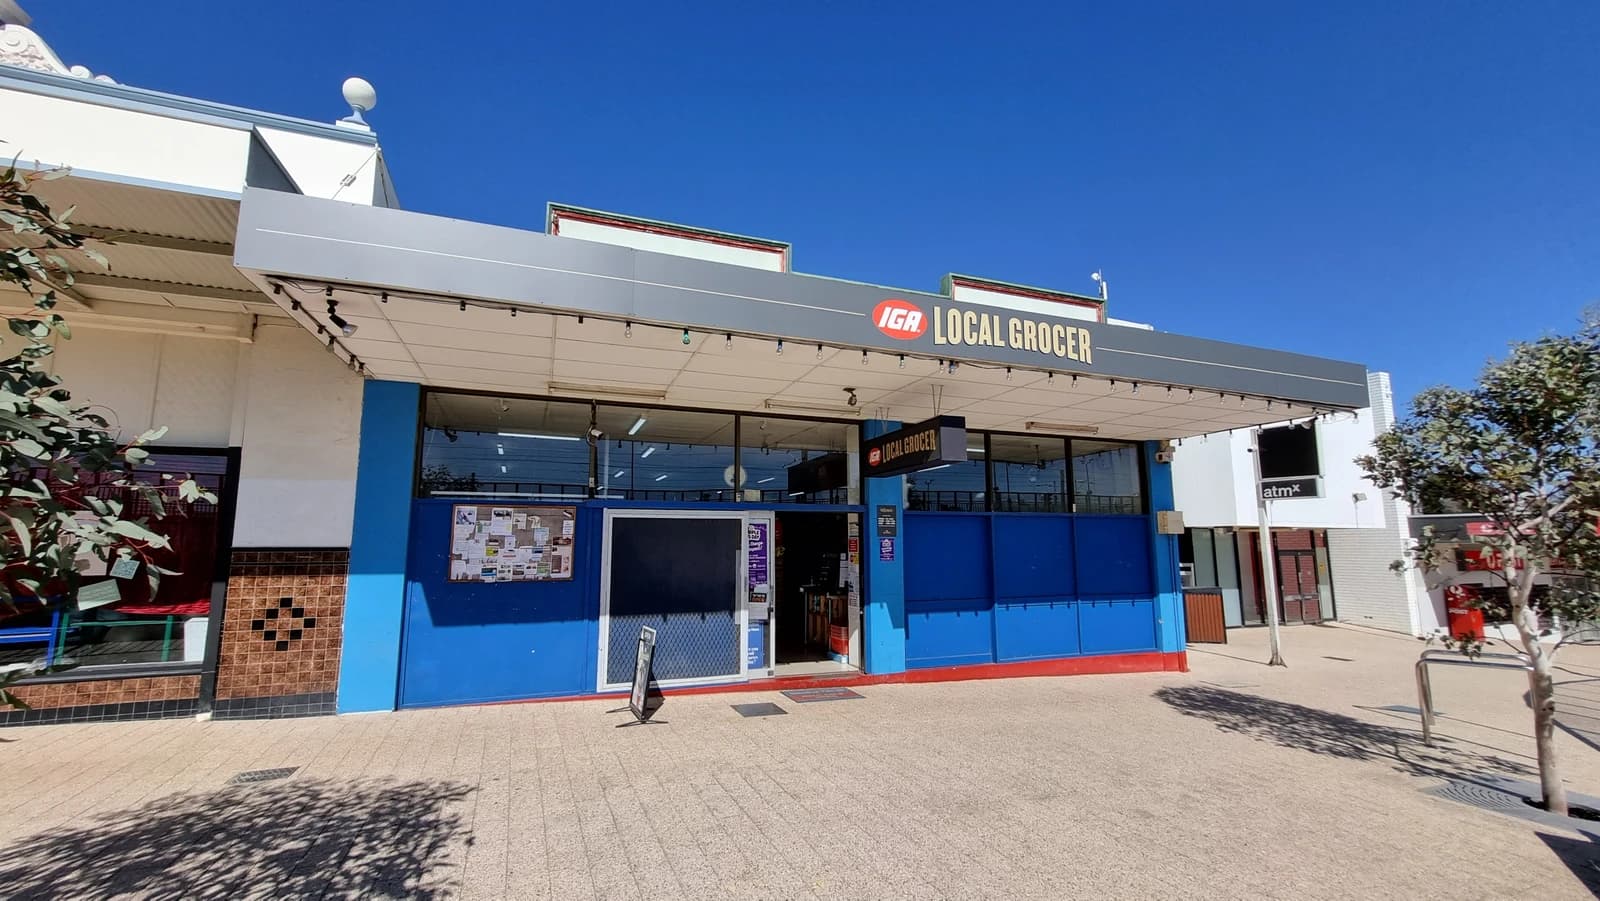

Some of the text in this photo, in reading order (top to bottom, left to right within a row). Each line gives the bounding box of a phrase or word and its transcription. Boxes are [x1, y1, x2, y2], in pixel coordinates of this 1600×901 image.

[878, 306, 1093, 364] IGA LOCAL GROCER
[882, 439, 904, 464] LOCAL
[904, 429, 936, 456] GROCER
